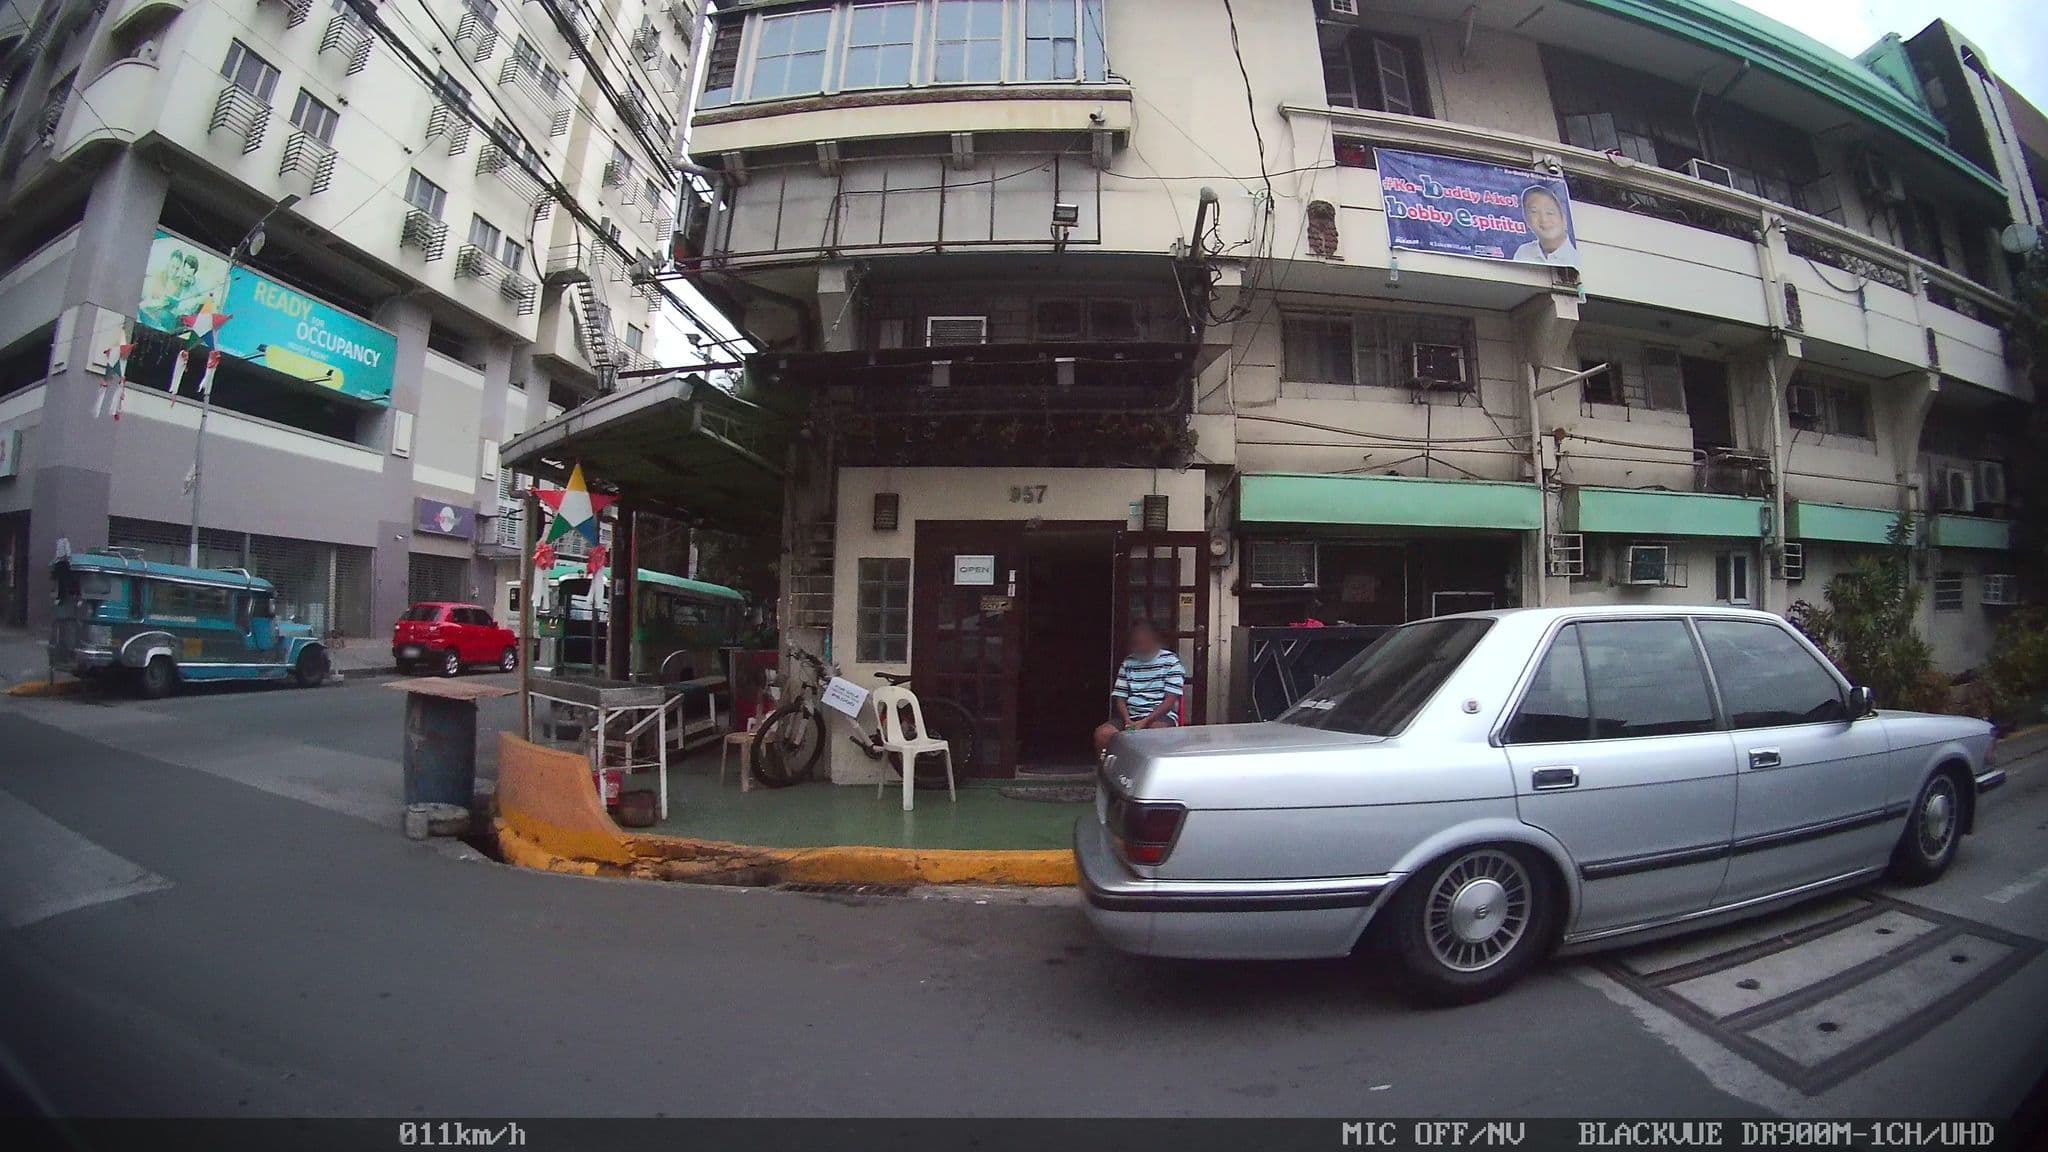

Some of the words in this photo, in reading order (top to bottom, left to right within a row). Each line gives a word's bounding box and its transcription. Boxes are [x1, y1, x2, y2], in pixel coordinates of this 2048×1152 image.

[1384, 196, 1453, 226] bobby
[1454, 208, 1527, 233] espiritu
[1484, 190, 1519, 207] Ako!
[254, 281, 313, 321] READY
[296, 321, 381, 367] OCCUPANCY
